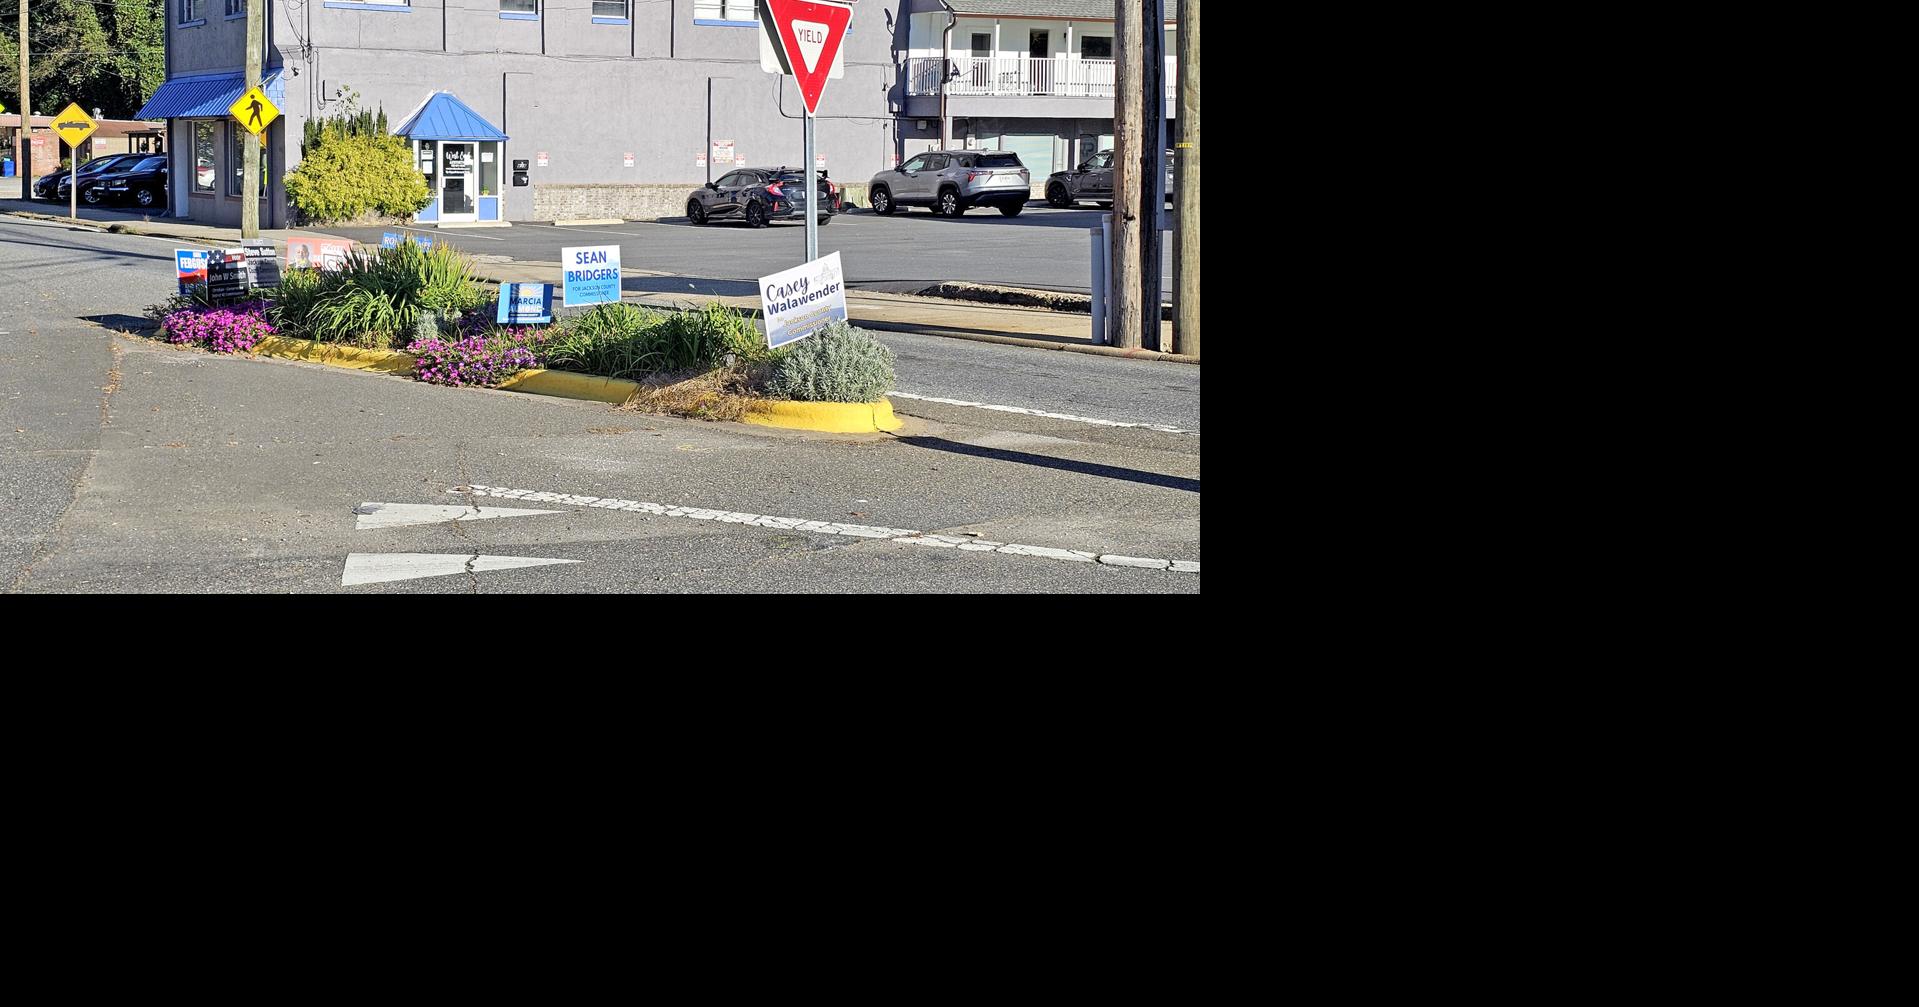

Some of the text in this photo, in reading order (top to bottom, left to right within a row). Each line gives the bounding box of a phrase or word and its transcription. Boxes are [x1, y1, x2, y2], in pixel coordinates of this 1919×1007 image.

[798, 28, 822, 43] YIELD
[575, 250, 607, 265] SEAN
[209, 272, 222, 283] John
[223, 272, 229, 281] W
[568, 268, 618, 283] BRIDGERS
[766, 276, 809, 302] Casey
[510, 297, 541, 305] MARCIA
[767, 282, 840, 315] Walawender
